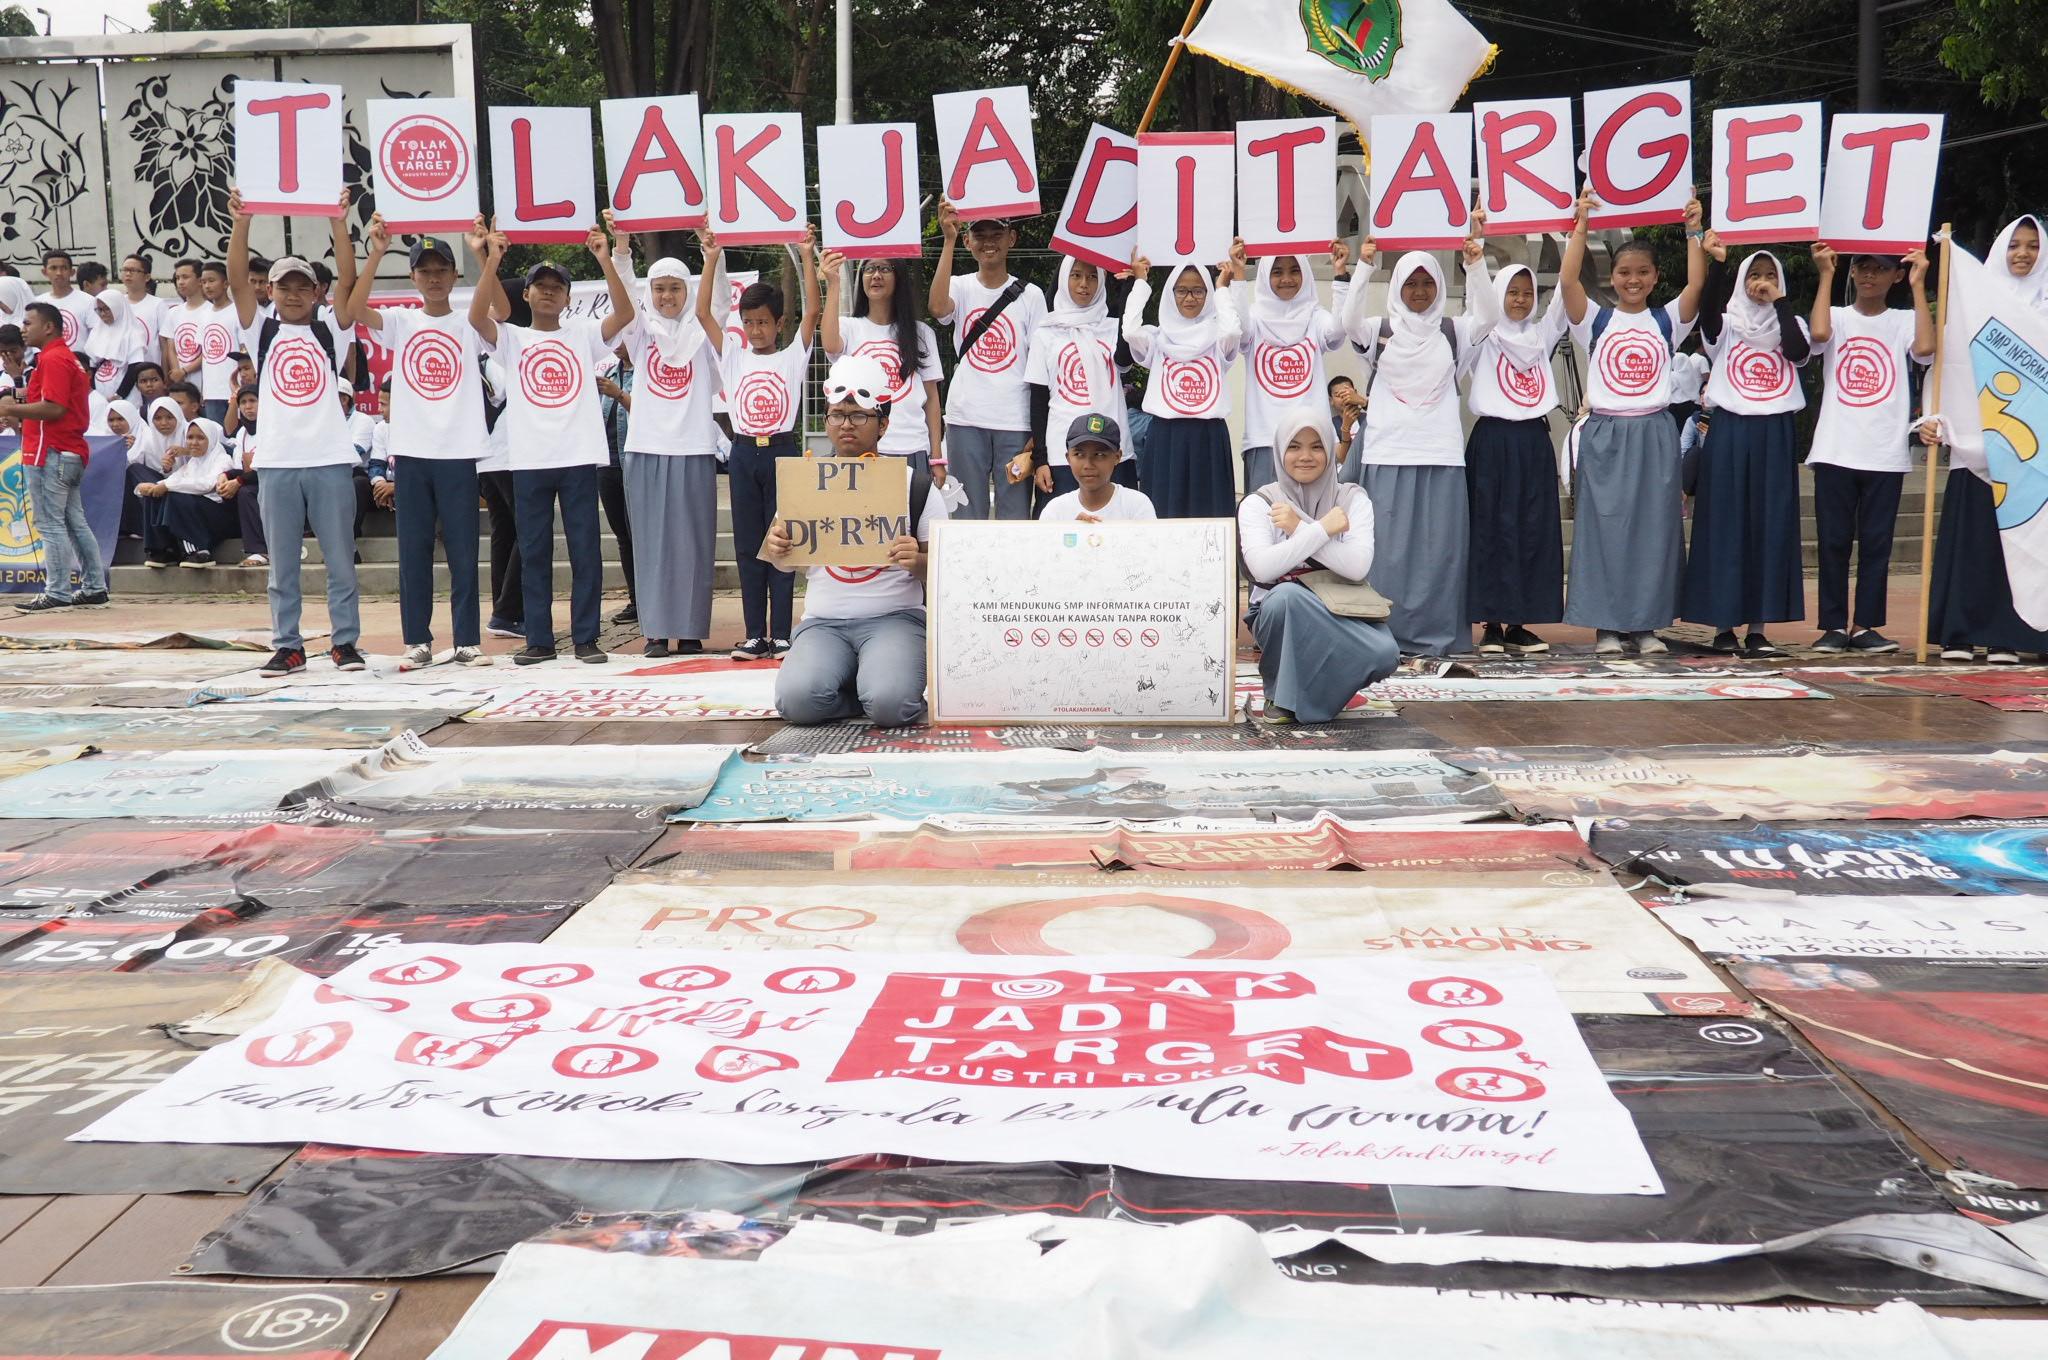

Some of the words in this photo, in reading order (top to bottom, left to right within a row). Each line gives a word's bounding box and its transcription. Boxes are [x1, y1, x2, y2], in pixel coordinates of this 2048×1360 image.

[247, 92, 330, 193] T
[399, 140, 447, 150] TOLAK
[408, 151, 441, 160] JADI
[947, 96, 1035, 200] A
[1588, 92, 1690, 205] G
[397, 161, 452, 171] TARGET
[511, 117, 576, 222] L
[612, 105, 704, 211] A
[1481, 110, 1572, 212] R
[1725, 114, 1807, 222] E
[714, 123, 798, 223] K
[835, 129, 904, 239] J
[1247, 126, 1325, 233] T
[1373, 121, 1468, 229] A
[1841, 122, 1930, 230] T
[1175, 156, 1196, 256] I
[1986, 328, 2011, 350] SMP
[816, 462, 865, 491] PT
[973, 601, 998, 610] KAMI
[1001, 601, 1062, 610] MENDUKUNG
[1064, 601, 1084, 610] SMP
[1086, 601, 1151, 610] INFORMATIKA
[1153, 601, 1191, 610] CIPUTAT
[982, 614, 1021, 623] SEBAGAI
[1023, 614, 1065, 623] SEKOLAH
[1068, 614, 1115, 623] KAWASAN
[1118, 614, 1147, 623] TANPA
[1150, 614, 1182, 623] ROKOK
[1146, 847, 1326, 864] SUPER
[1730, 869, 1799, 881] NEW
[640, 906, 878, 932] PRO
[1700, 916, 2028, 931] MAXUS
[1363, 935, 1593, 951] STRONG
[1780, 943, 1912, 954] 13.000
[928, 973, 1292, 999] TOLAK
[903, 1002, 1167, 1032] JADI
[1708, 1029, 1752, 1040] 18+
[895, 1033, 1388, 1073] TARGET
[874, 1066, 1095, 1085] INDUSTRI
[1122, 1060, 1280, 1084] ROKOK
[1966, 1195, 2041, 1211] NEW
[245, 1304, 339, 1339] 18+
